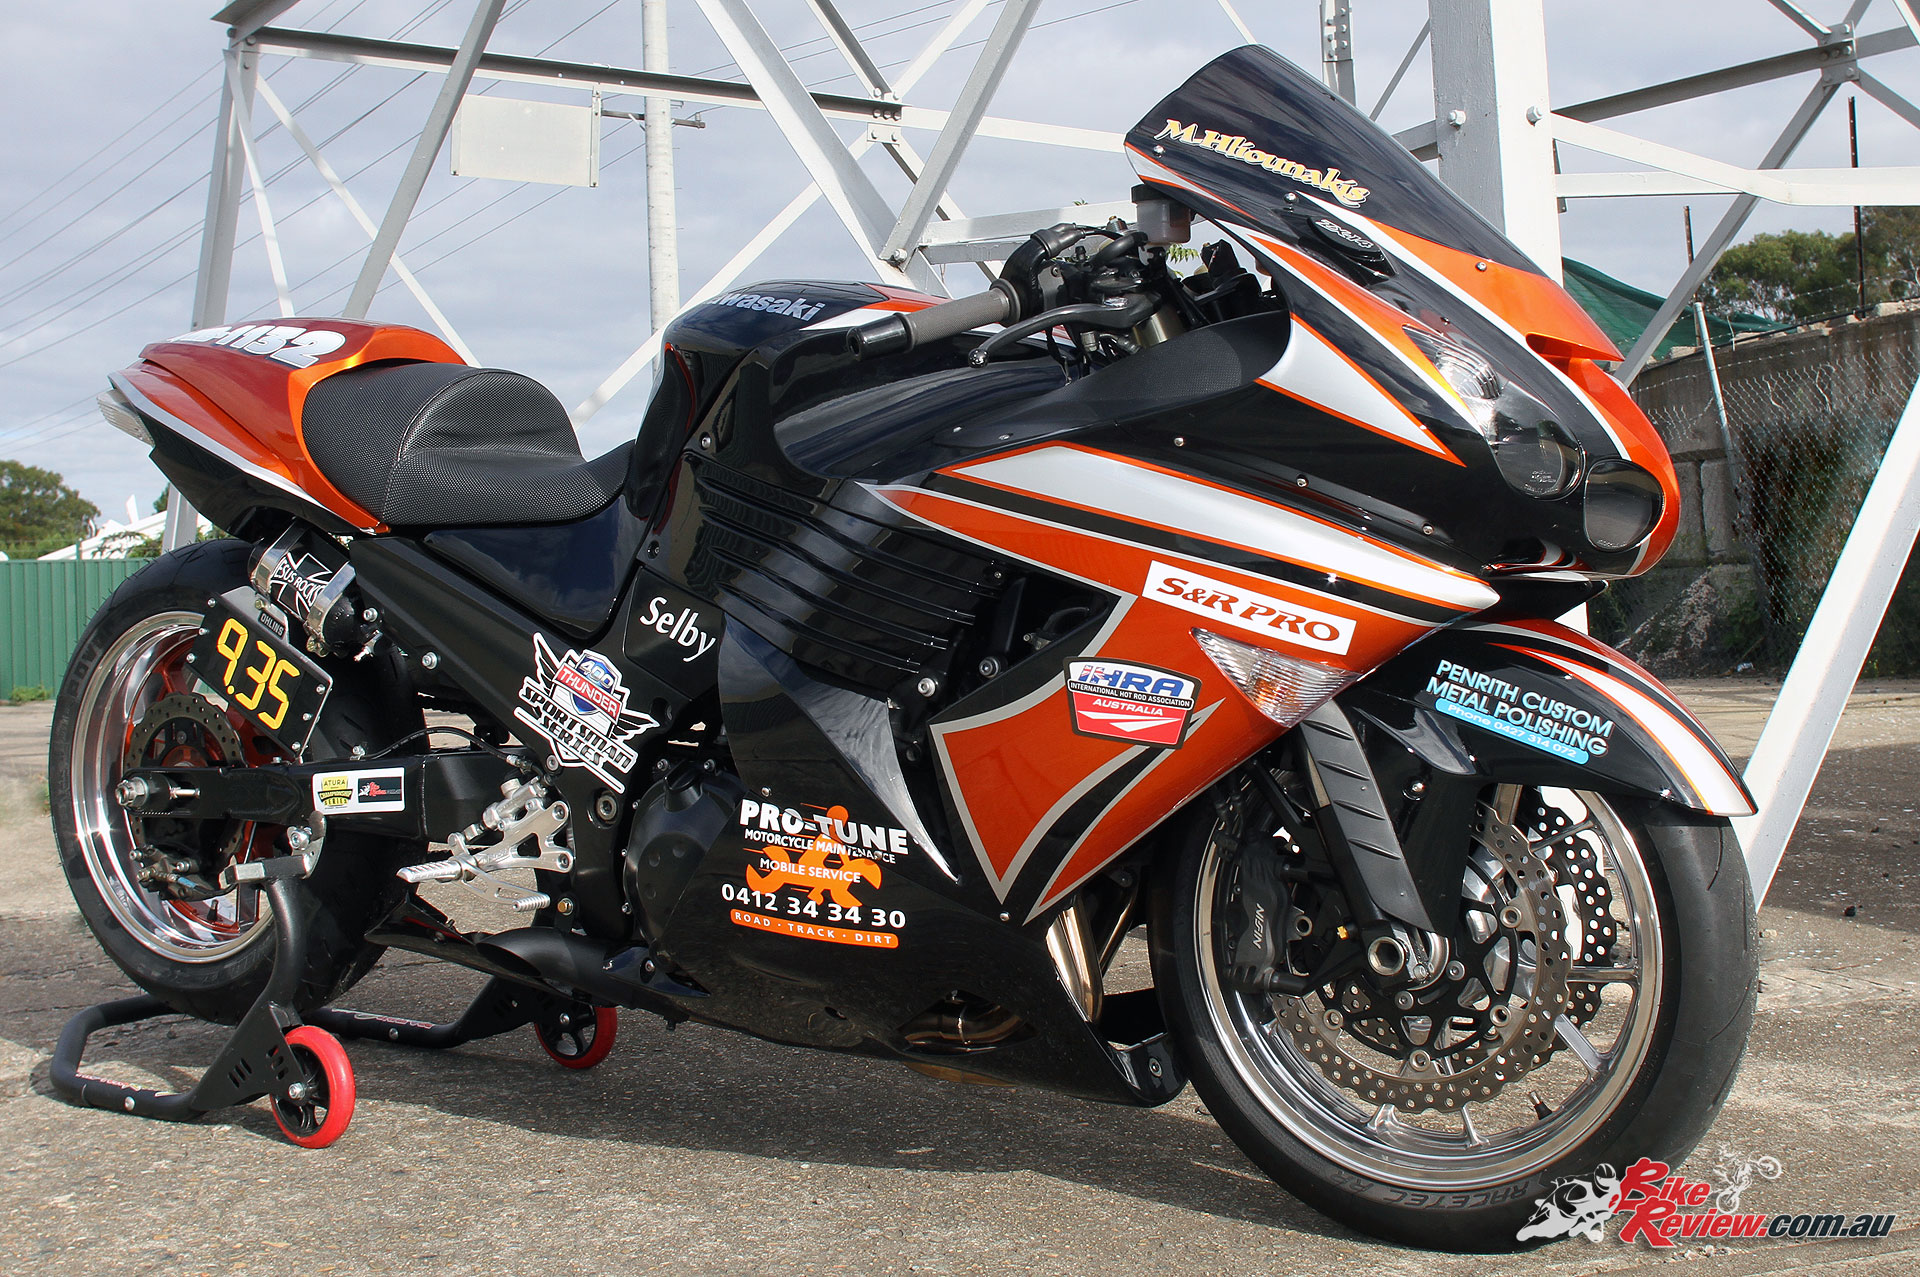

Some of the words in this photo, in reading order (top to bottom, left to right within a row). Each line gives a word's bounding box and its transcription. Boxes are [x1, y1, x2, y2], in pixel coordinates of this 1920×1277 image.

[706, 292, 826, 322] wasaki
[639, 596, 717, 662] Selby
[1156, 577, 1239, 614] S&R
[1239, 602, 1339, 641] PRO
[217, 617, 300, 730] 9.35
[557, 667, 619, 719] THUNDER
[579, 660, 614, 689] 400
[1070, 681, 1118, 697] INTERNATIONAL
[1119, 690, 1132, 699] HOT
[1133, 692, 1147, 701] ROD
[1147, 694, 1191, 707] ASSOCIATION
[1078, 664, 1185, 698] IHRA
[1092, 698, 1164, 716] AUSTRALIA
[1426, 676, 1490, 714] METAL
[1494, 700, 1608, 756] POLISHING
[1436, 659, 1521, 704] PENRITH
[1521, 691, 1615, 738] CUSTOM
[521, 686, 633, 769] SPORTSMAN
[540, 713, 604, 766] SERIES
[1448, 704, 1492, 725] Phone
[1494, 721, 1525, 737] 0427
[1528, 734, 1551, 749] 314
[1552, 742, 1577, 758] 072
[323, 779, 346, 787] ATURA
[739, 799, 909, 855] PRO-TUNE
[744, 828, 814, 850] MOTORCYCLE
[759, 857, 806, 876] MOBILE
[808, 866, 861, 883] SERVICE
[721, 883, 779, 912] 0412
[786, 896, 819, 918] 34
[827, 903, 862, 924] 34
[871, 908, 906, 929] 30
[735, 911, 772, 928] ROAD
[788, 922, 836, 939] TRACK
[855, 933, 893, 945] DIRT
[1383, 1180, 1529, 1210] RACETEC
